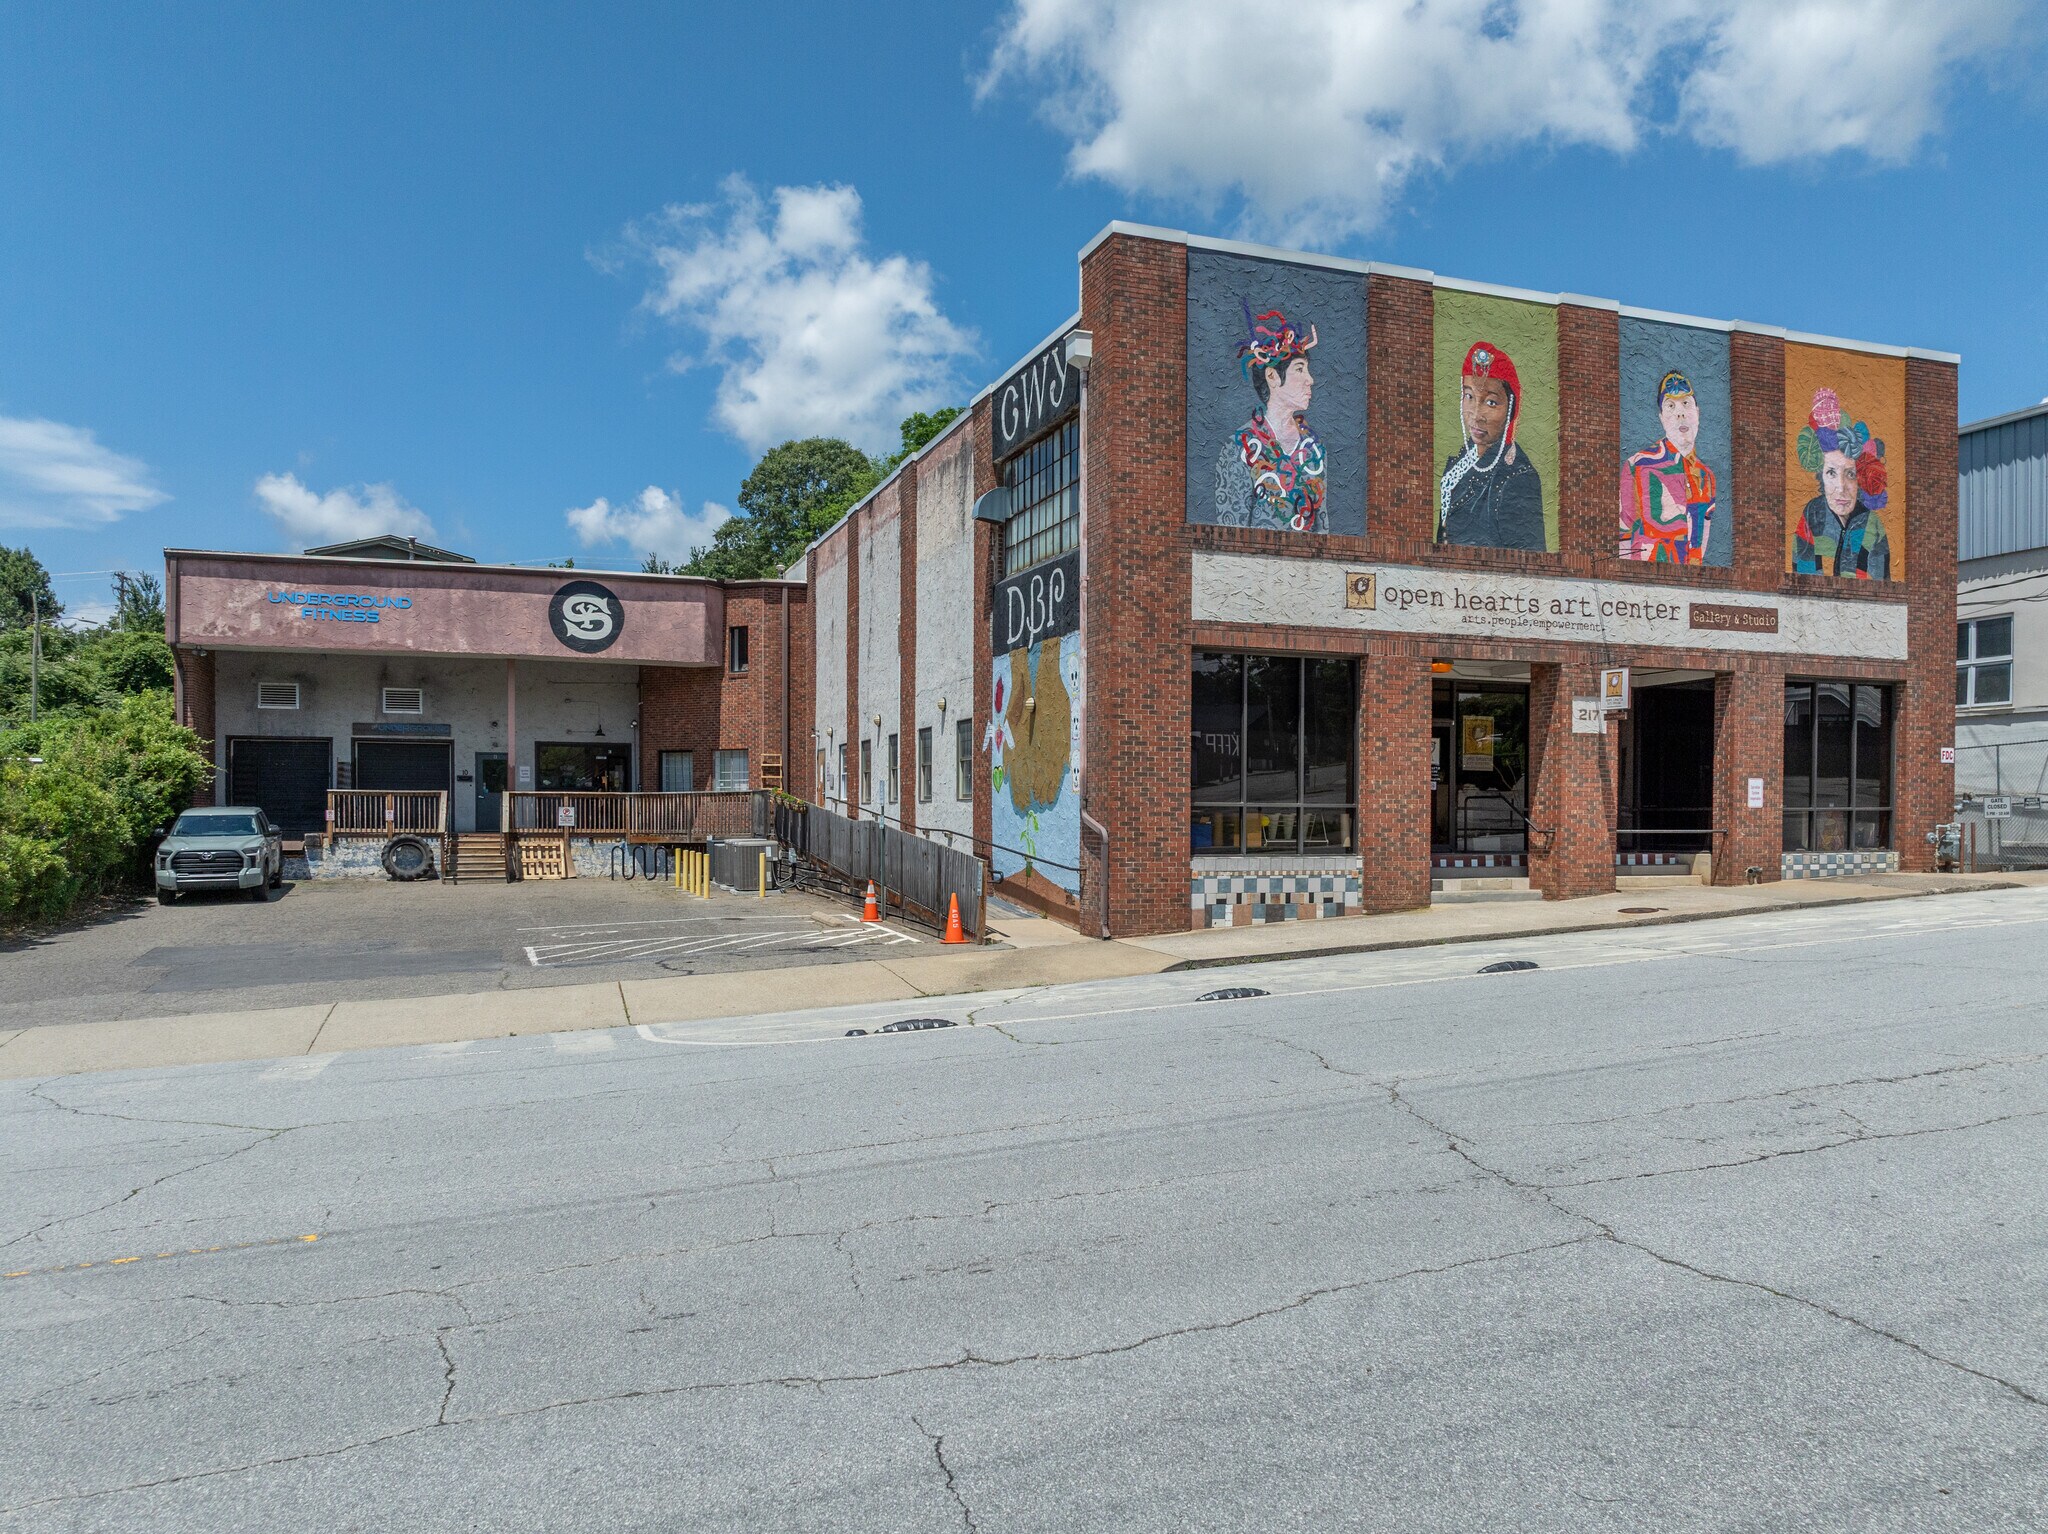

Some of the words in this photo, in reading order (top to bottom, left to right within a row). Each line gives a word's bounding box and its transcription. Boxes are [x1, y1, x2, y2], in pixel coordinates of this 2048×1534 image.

[268, 591, 413, 609] UNDERGROUND
[1384, 587, 1444, 610] open
[1454, 588, 1540, 614] hearts
[1550, 596, 1595, 618] art
[1601, 600, 1681, 621] center
[302, 608, 380, 623] FITNESS
[1693, 610, 1731, 627] Gallery
[1734, 615, 1740, 624] &
[1743, 613, 1776, 626] Studio
[1579, 709, 1599, 720] 217
[1942, 750, 1954, 760] FDC
